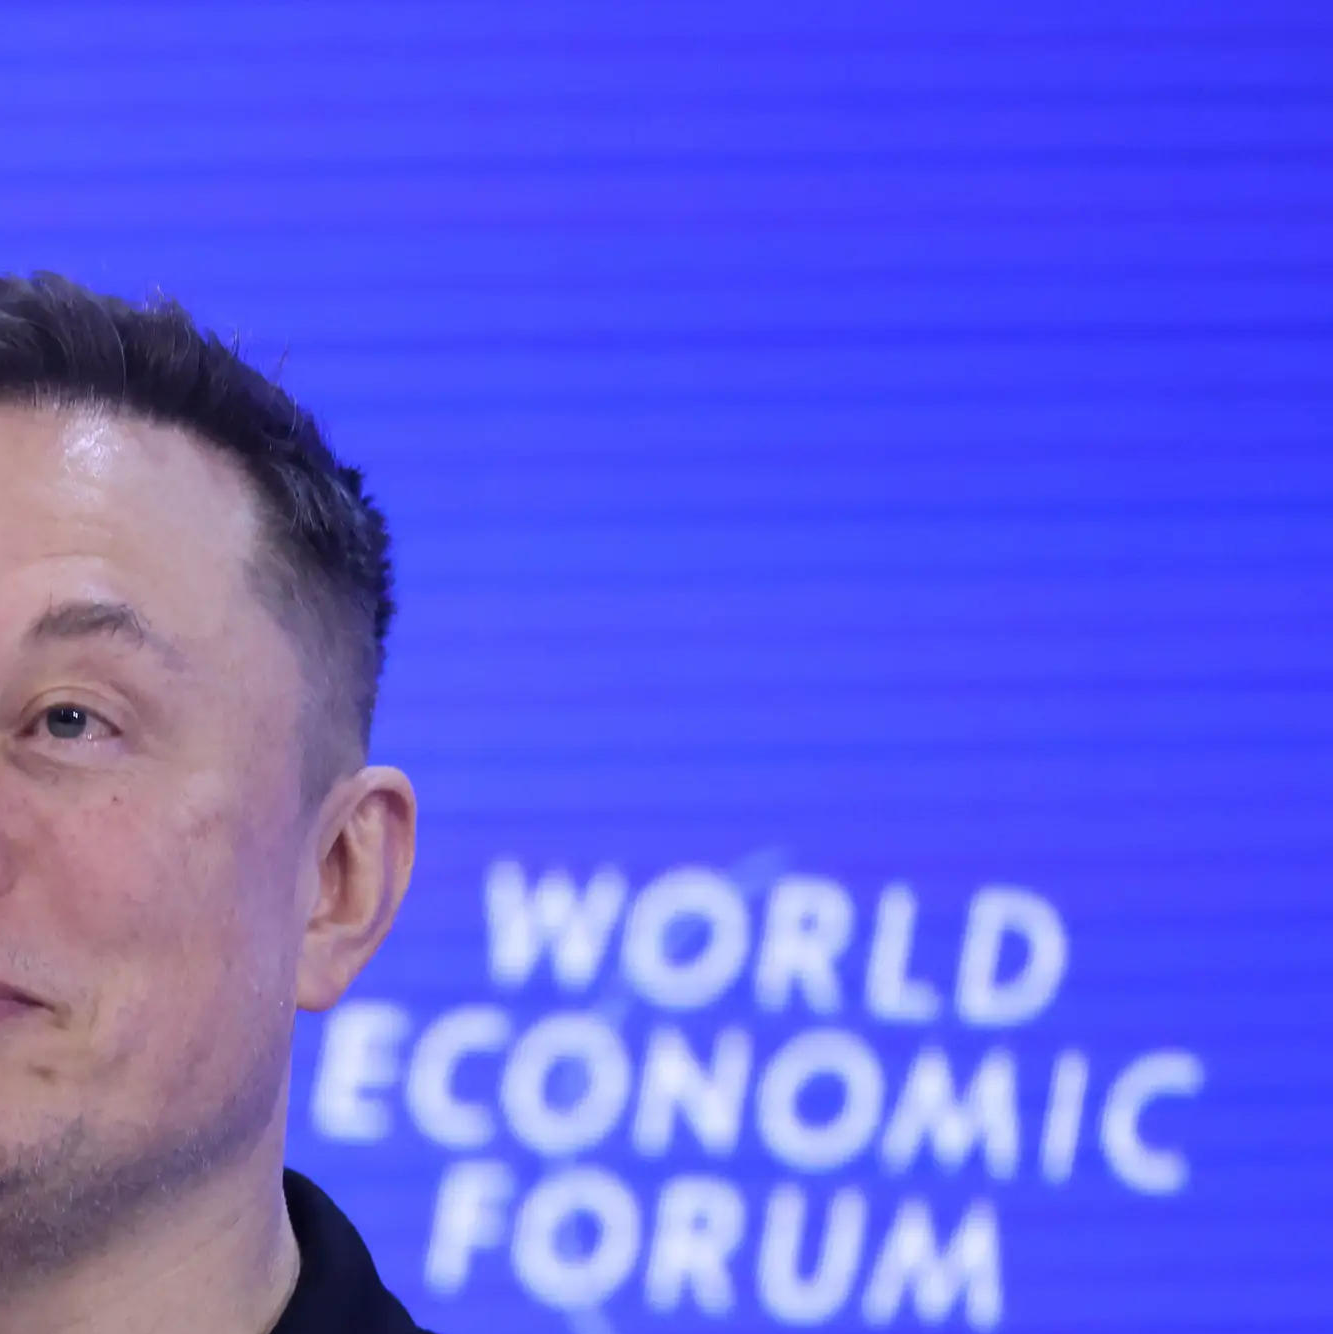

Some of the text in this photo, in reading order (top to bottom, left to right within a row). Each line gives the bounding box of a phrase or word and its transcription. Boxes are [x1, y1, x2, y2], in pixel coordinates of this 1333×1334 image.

[483, 858, 1068, 1026] WORLD
[311, 1001, 1203, 1194] ECONOMIC
[424, 1158, 1004, 1332] FORUM
